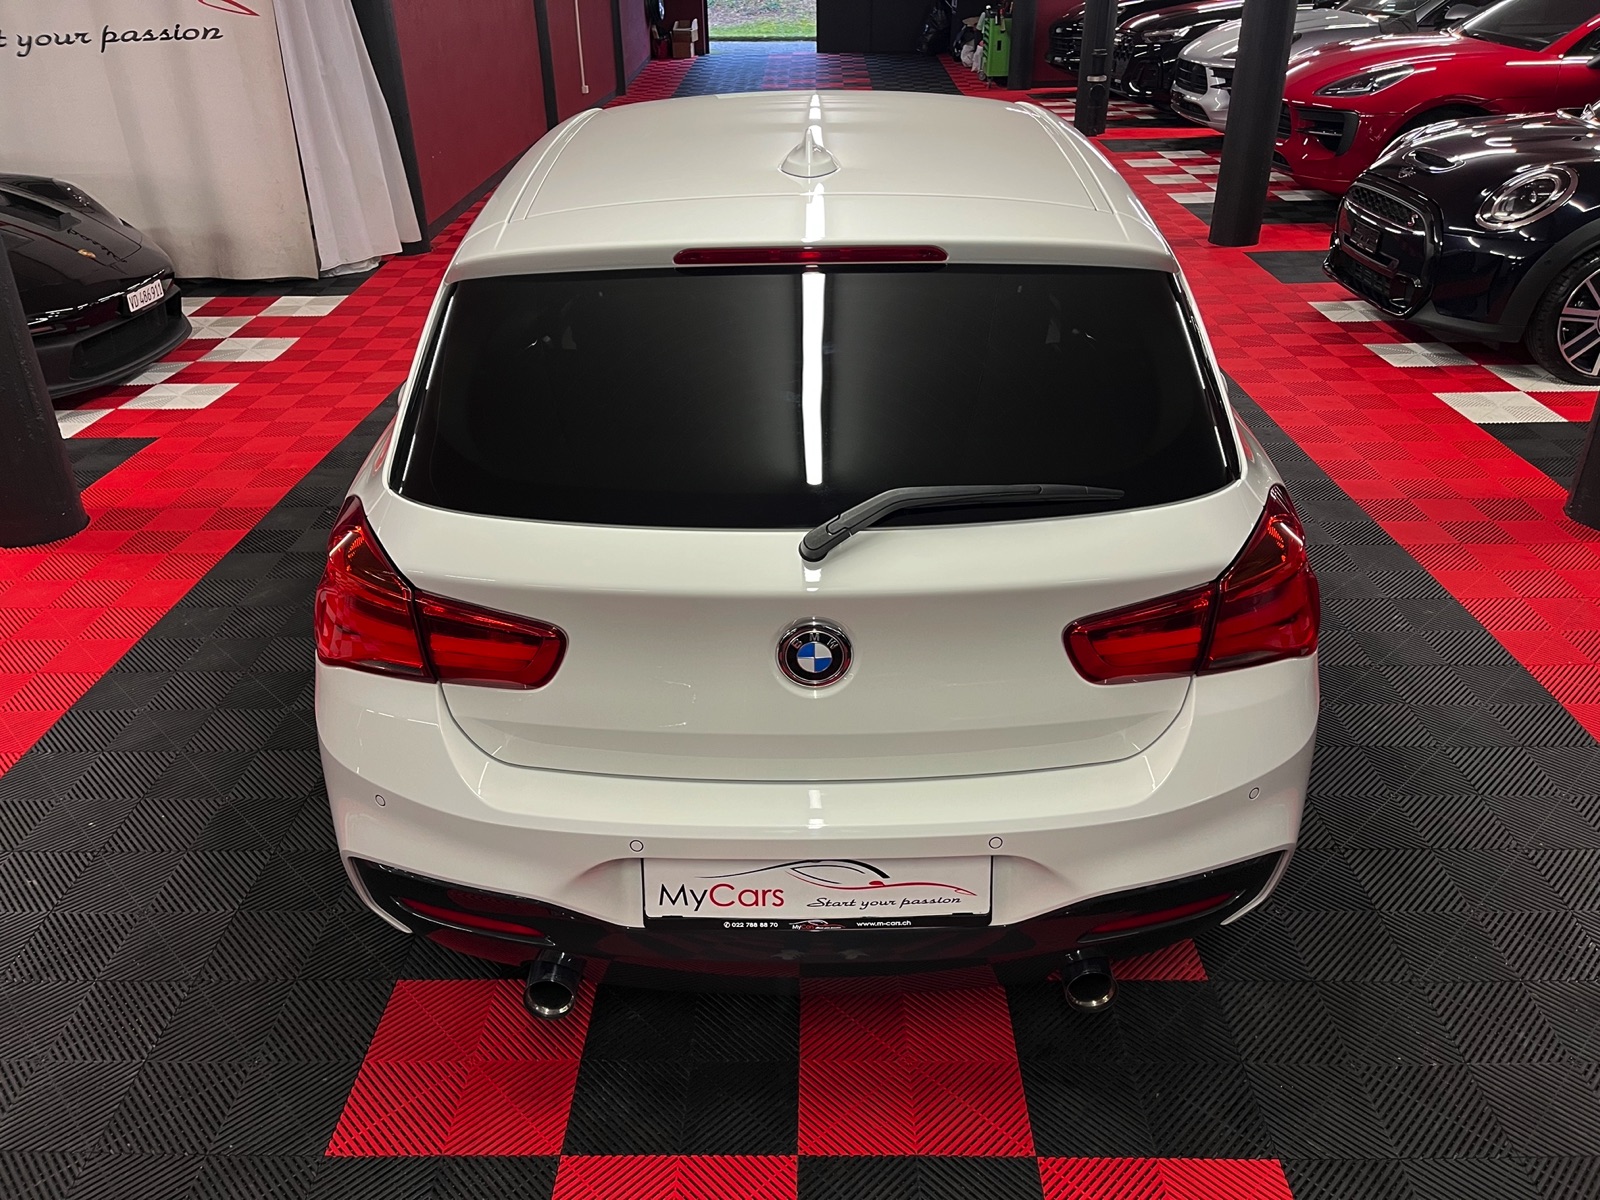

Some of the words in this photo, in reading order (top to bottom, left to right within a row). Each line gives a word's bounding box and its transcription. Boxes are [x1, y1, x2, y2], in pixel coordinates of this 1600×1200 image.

[16, 32, 92, 57] your
[100, 24, 223, 53] passion
[129, 294, 139, 309] VD
[791, 632, 839, 650] BMW
[659, 883, 785, 911] MyCars
[806, 897, 857, 908] Start
[859, 899, 897, 910] your
[899, 896, 961, 908] passion
